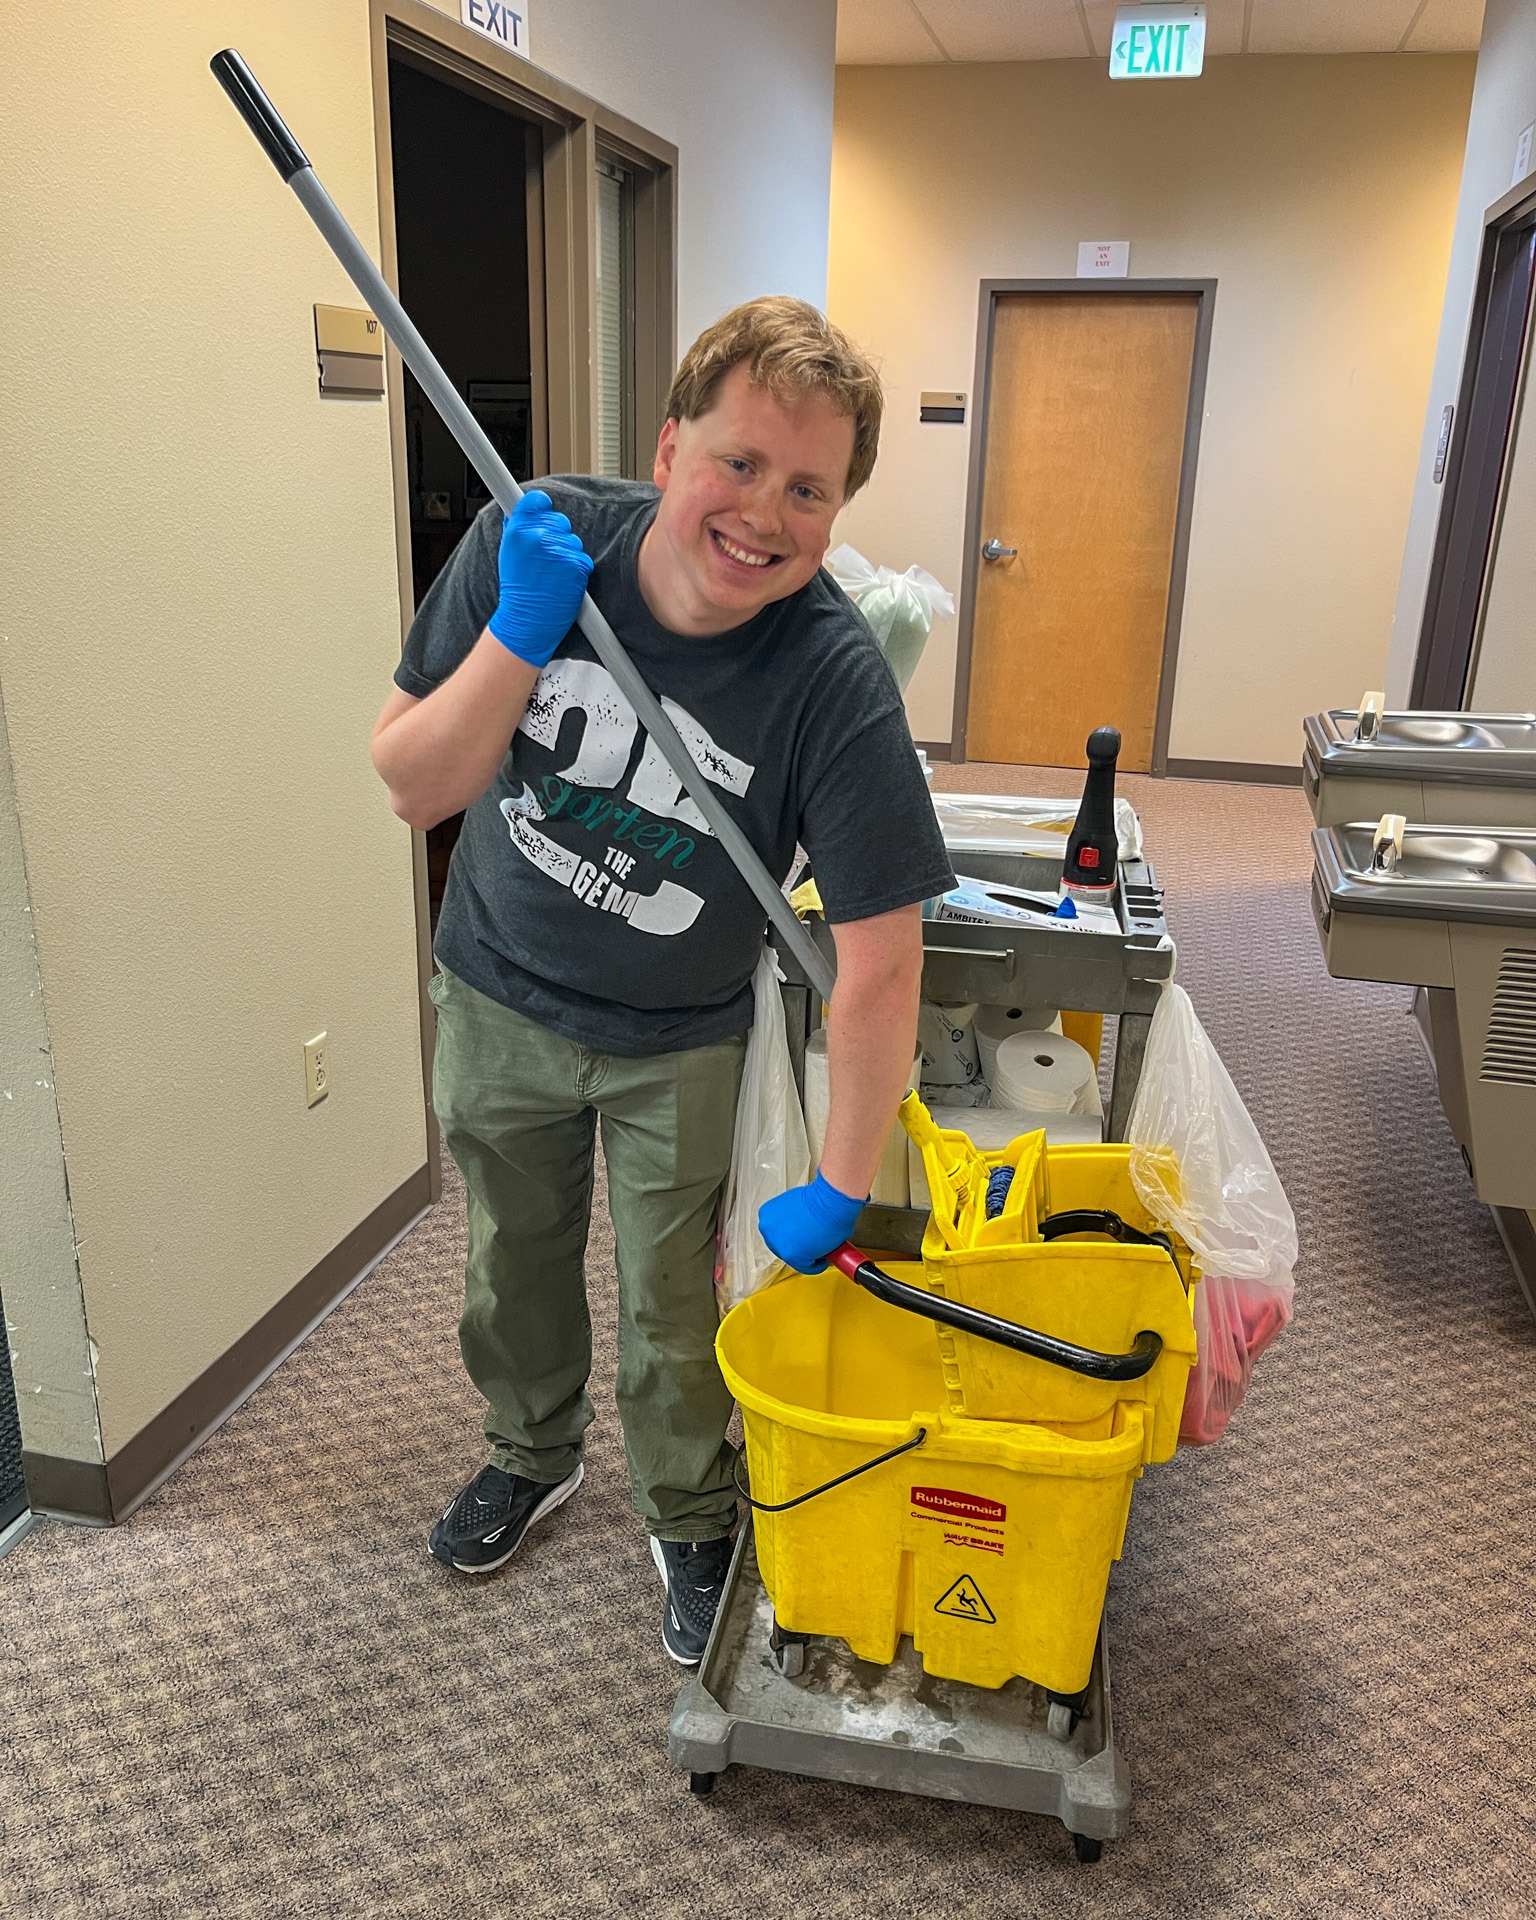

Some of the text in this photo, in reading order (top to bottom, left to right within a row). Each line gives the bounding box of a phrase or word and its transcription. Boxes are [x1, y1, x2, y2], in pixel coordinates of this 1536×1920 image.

[469, 0, 522, 47] EXIT
[1127, 25, 1190, 73] EXIT
[366, 320, 378, 334] 107
[537, 775, 696, 870] garten
[603, 846, 637, 881] THE
[572, 861, 640, 919] GEM
[915, 1491, 1002, 1518] Rubbermaid
[910, 1511, 1005, 1536] Commercial Products
[943, 1532, 1005, 1550] WAVE BRAKE
